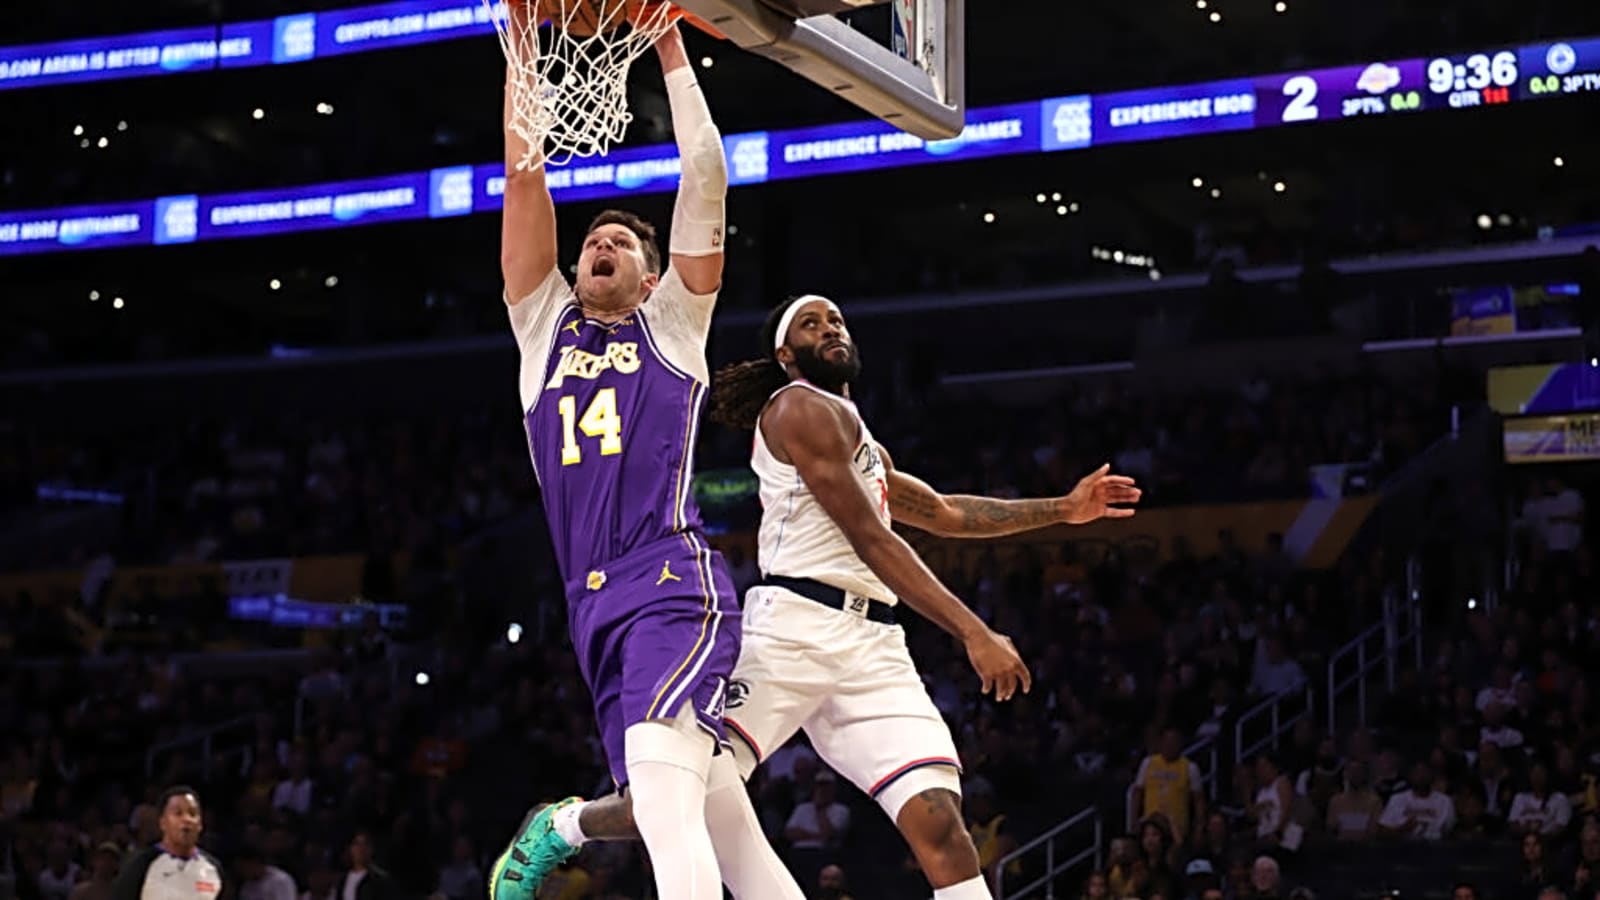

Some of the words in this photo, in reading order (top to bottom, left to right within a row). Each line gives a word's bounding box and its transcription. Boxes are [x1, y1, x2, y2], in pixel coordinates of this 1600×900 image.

[335, 14, 424, 43] CRYPTO.COM
[426, 7, 474, 30] ARENA
[41, 53, 88, 75] ARENA
[88, 50, 105, 70] IS
[106, 46, 160, 69] BETTER
[1427, 51, 1518, 93] 9:36
[1282, 76, 1319, 122] 2
[1448, 90, 1481, 108] QTR
[1529, 75, 1559, 94] 0.0
[1109, 98, 1212, 128] EXPERIENCE
[1342, 97, 1386, 116] 3PT%
[1390, 91, 1420, 110] 0.0
[784, 135, 877, 163] EXPERIENCE
[573, 165, 614, 186] MORE
[211, 201, 292, 225] EXPERIENCE
[294, 196, 332, 217] MORE
[20, 220, 58, 241] MORE
[558, 387, 622, 466] 14
